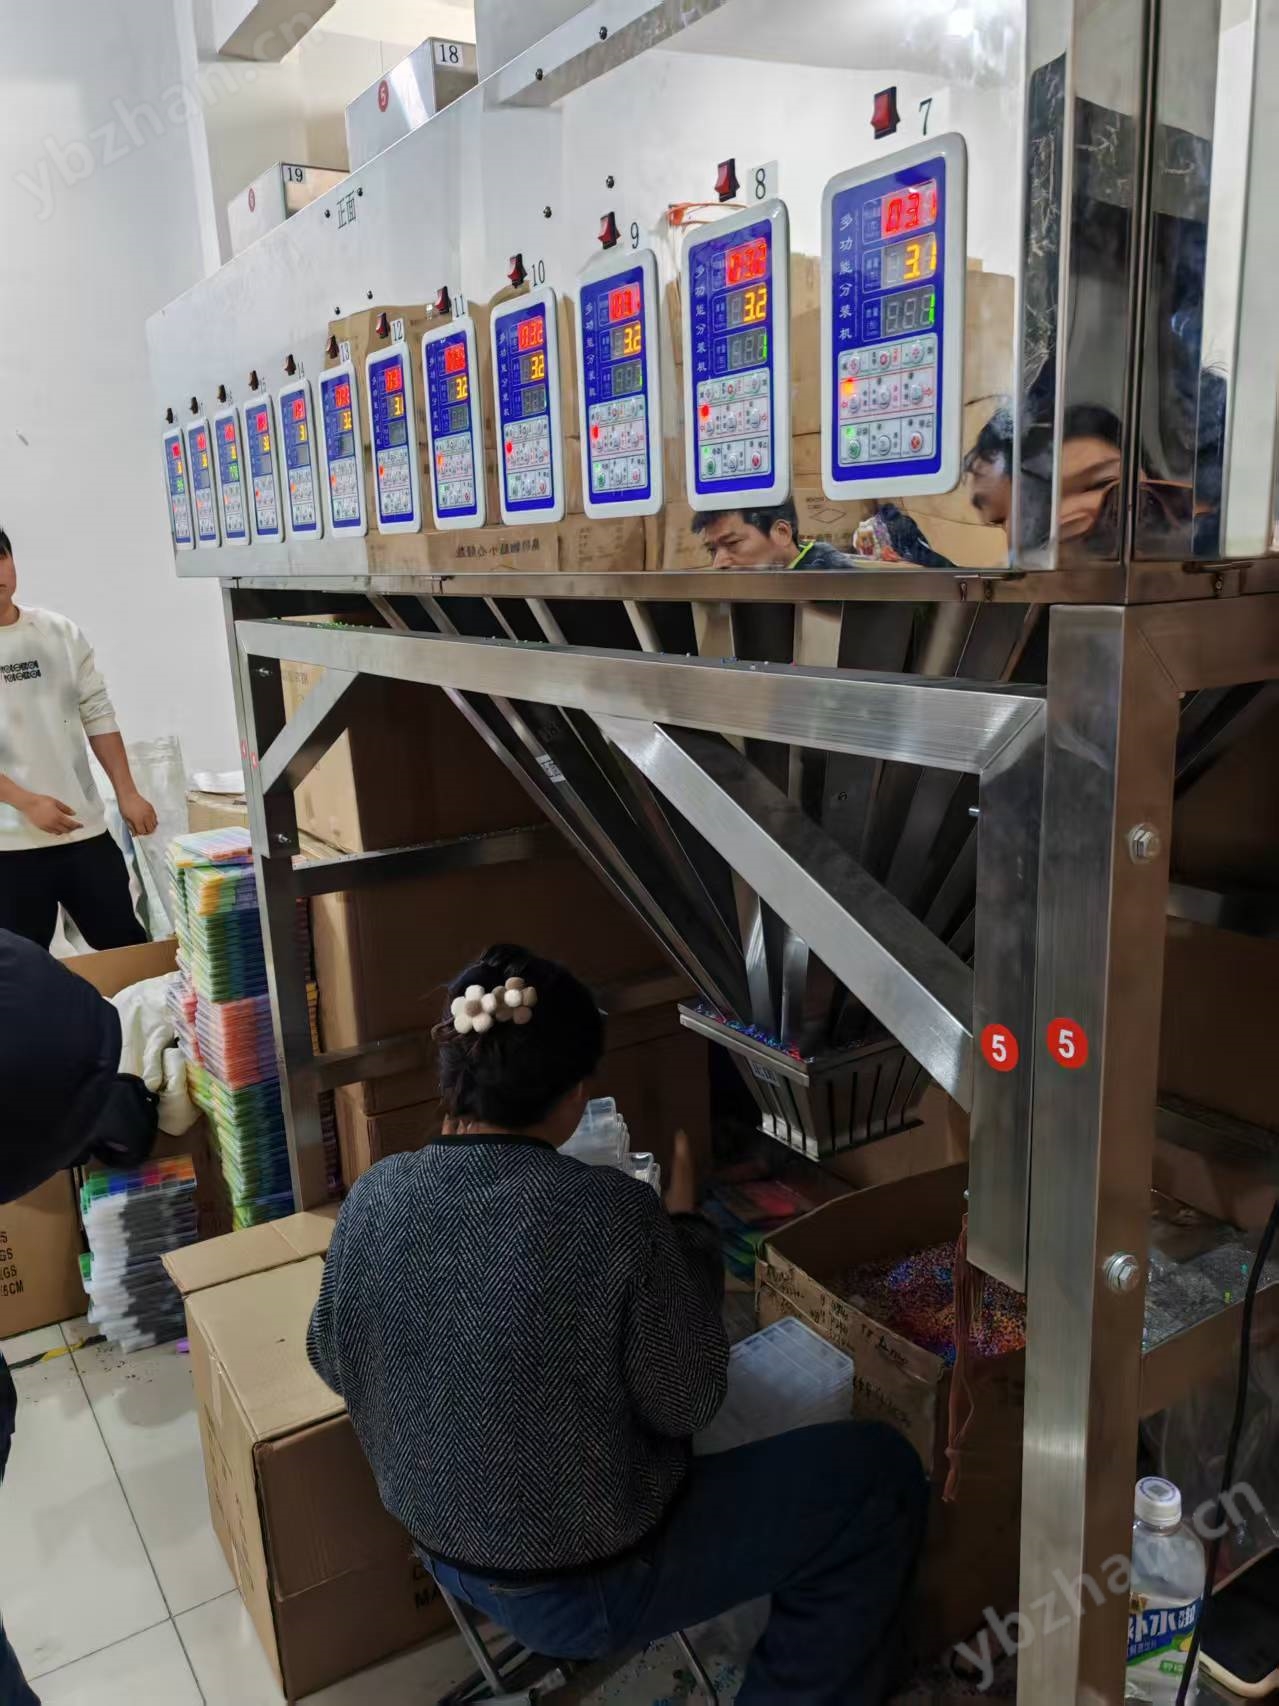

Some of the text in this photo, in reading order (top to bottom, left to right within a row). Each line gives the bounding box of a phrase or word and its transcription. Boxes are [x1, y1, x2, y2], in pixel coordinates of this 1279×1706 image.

[440, 44, 459, 64] 18
[918, 97, 933, 136] 7
[286, 167, 303, 183] 19
[755, 168, 766, 200] 8
[336, 190, 356, 229] 正面
[630, 221, 640, 249] 9
[531, 259, 546, 287] 10
[454, 295, 465, 318] 11
[393, 320, 403, 341] 12
[992, 1033, 1007, 1062] 5
[1058, 1028, 1075, 1059] 5
[0, 1264, 17, 1280] GS
